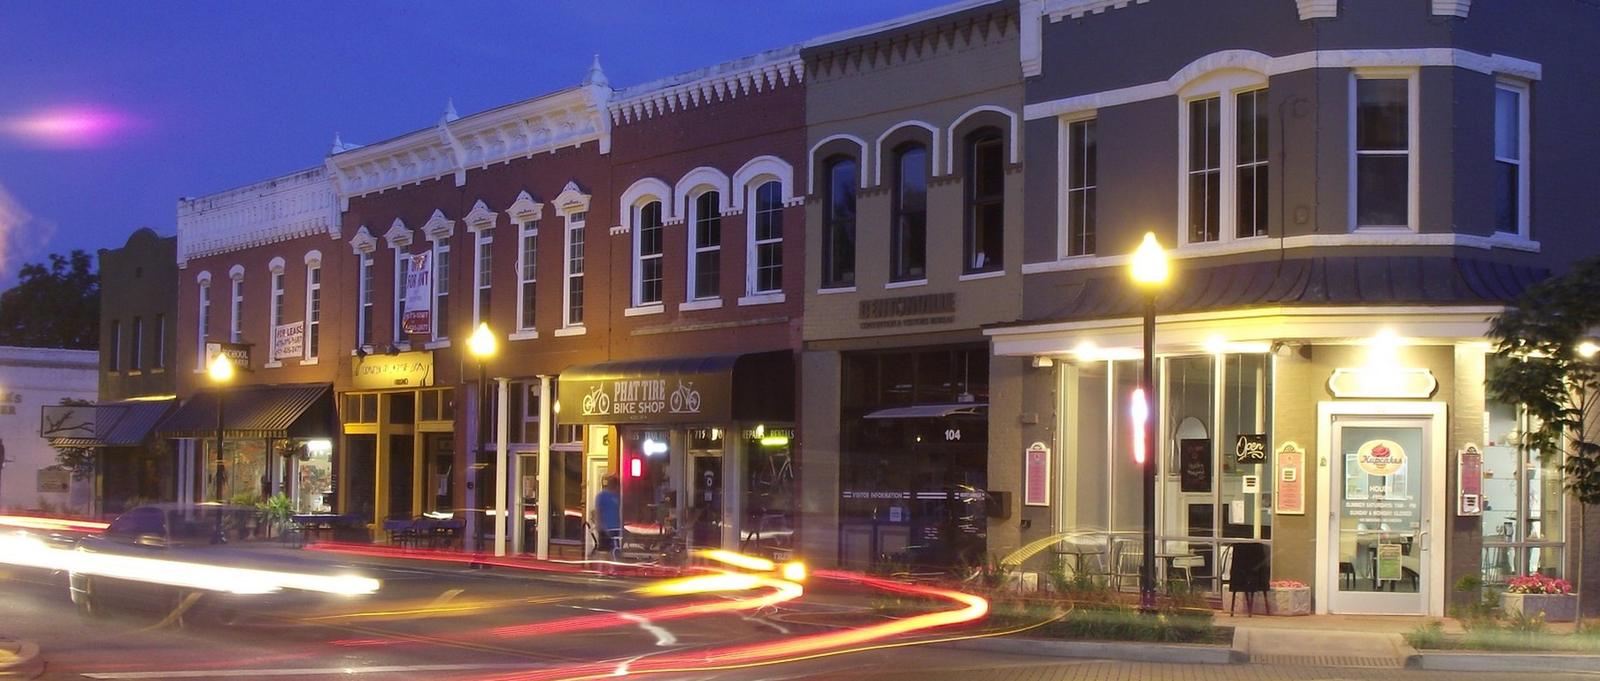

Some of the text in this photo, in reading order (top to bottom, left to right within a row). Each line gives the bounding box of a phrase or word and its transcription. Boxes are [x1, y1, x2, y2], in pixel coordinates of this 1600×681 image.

[613, 379, 666, 401] PHAT TIRE
[613, 401, 666, 414] BIKE SHOP
[743, 429, 765, 439] REPAS
[944, 429, 961, 441] 104
[1236, 436, 1265, 461] Open
[1360, 455, 1403, 465] Kupcakes
